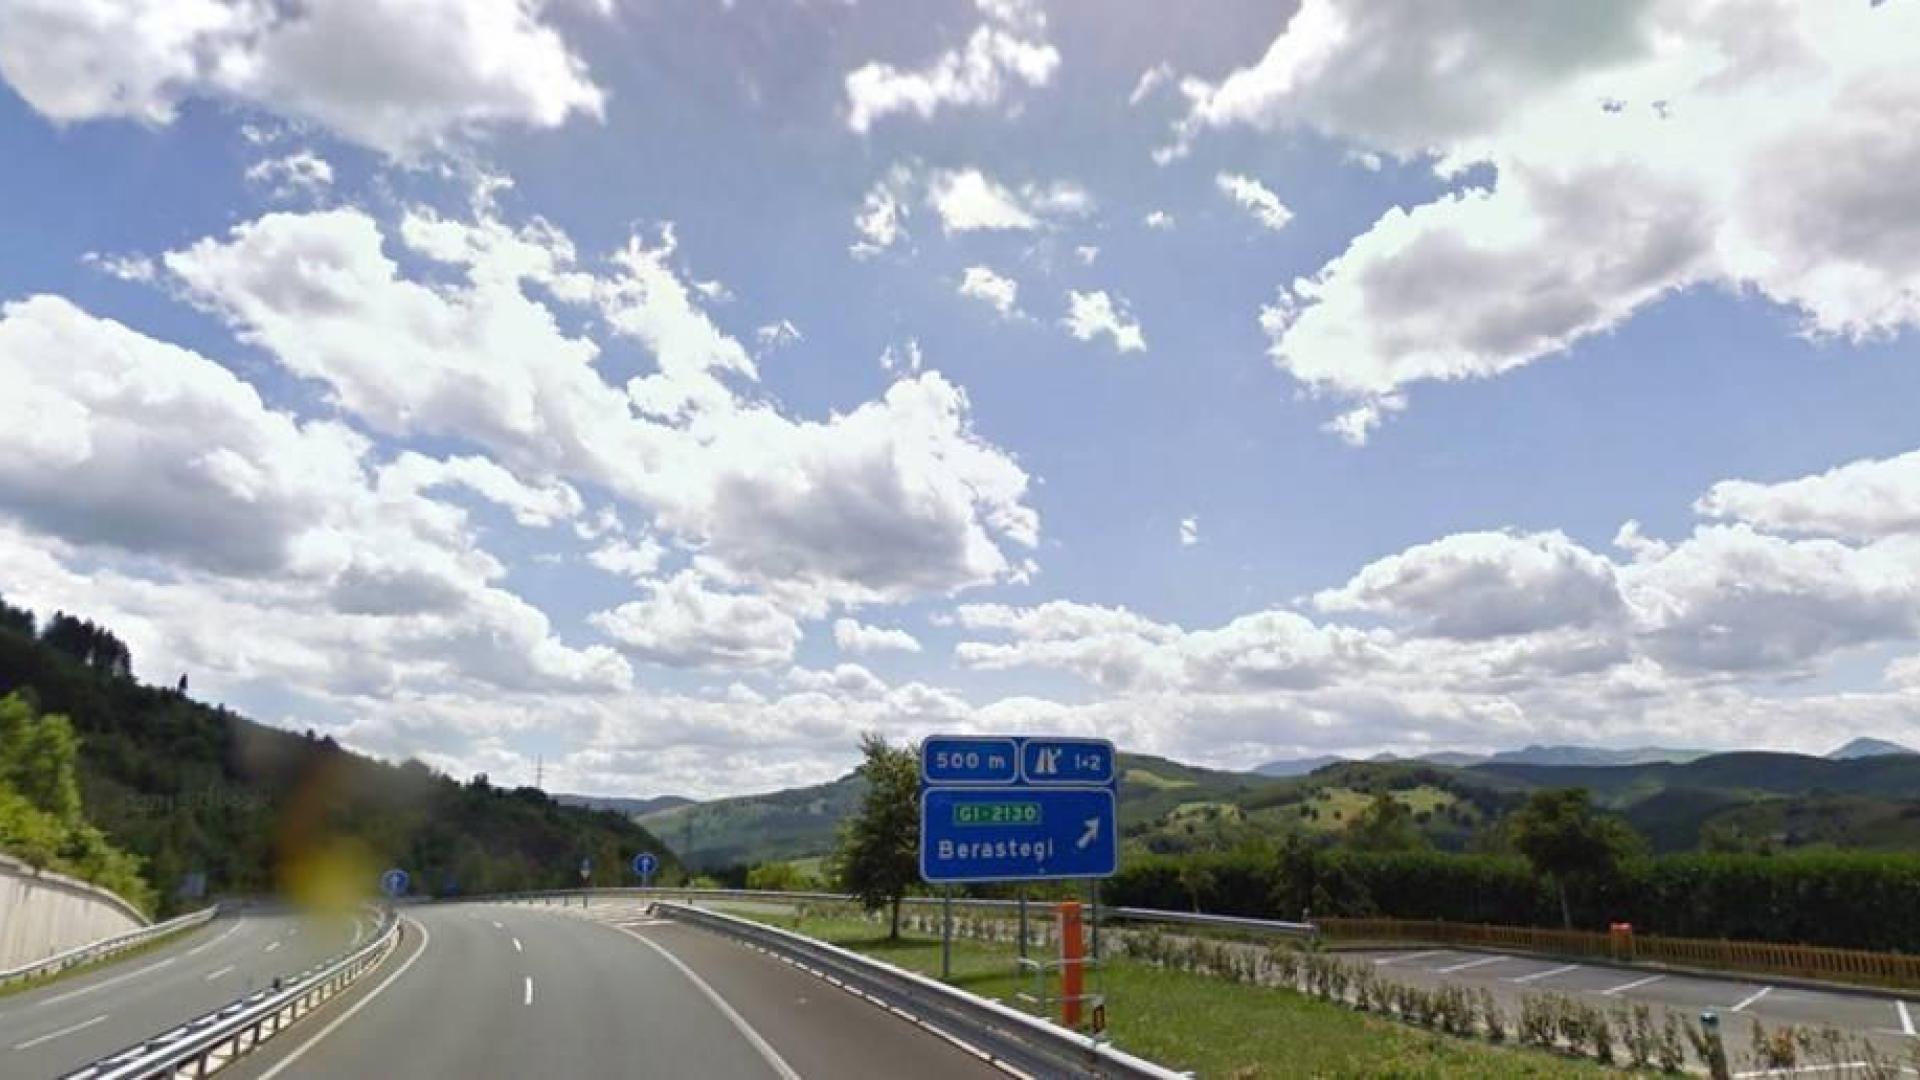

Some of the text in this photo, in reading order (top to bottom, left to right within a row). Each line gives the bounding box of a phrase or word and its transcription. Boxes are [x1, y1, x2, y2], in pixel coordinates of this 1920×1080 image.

[936, 752, 1005, 769] 500 m
[938, 838, 1054, 861] Berastegi
